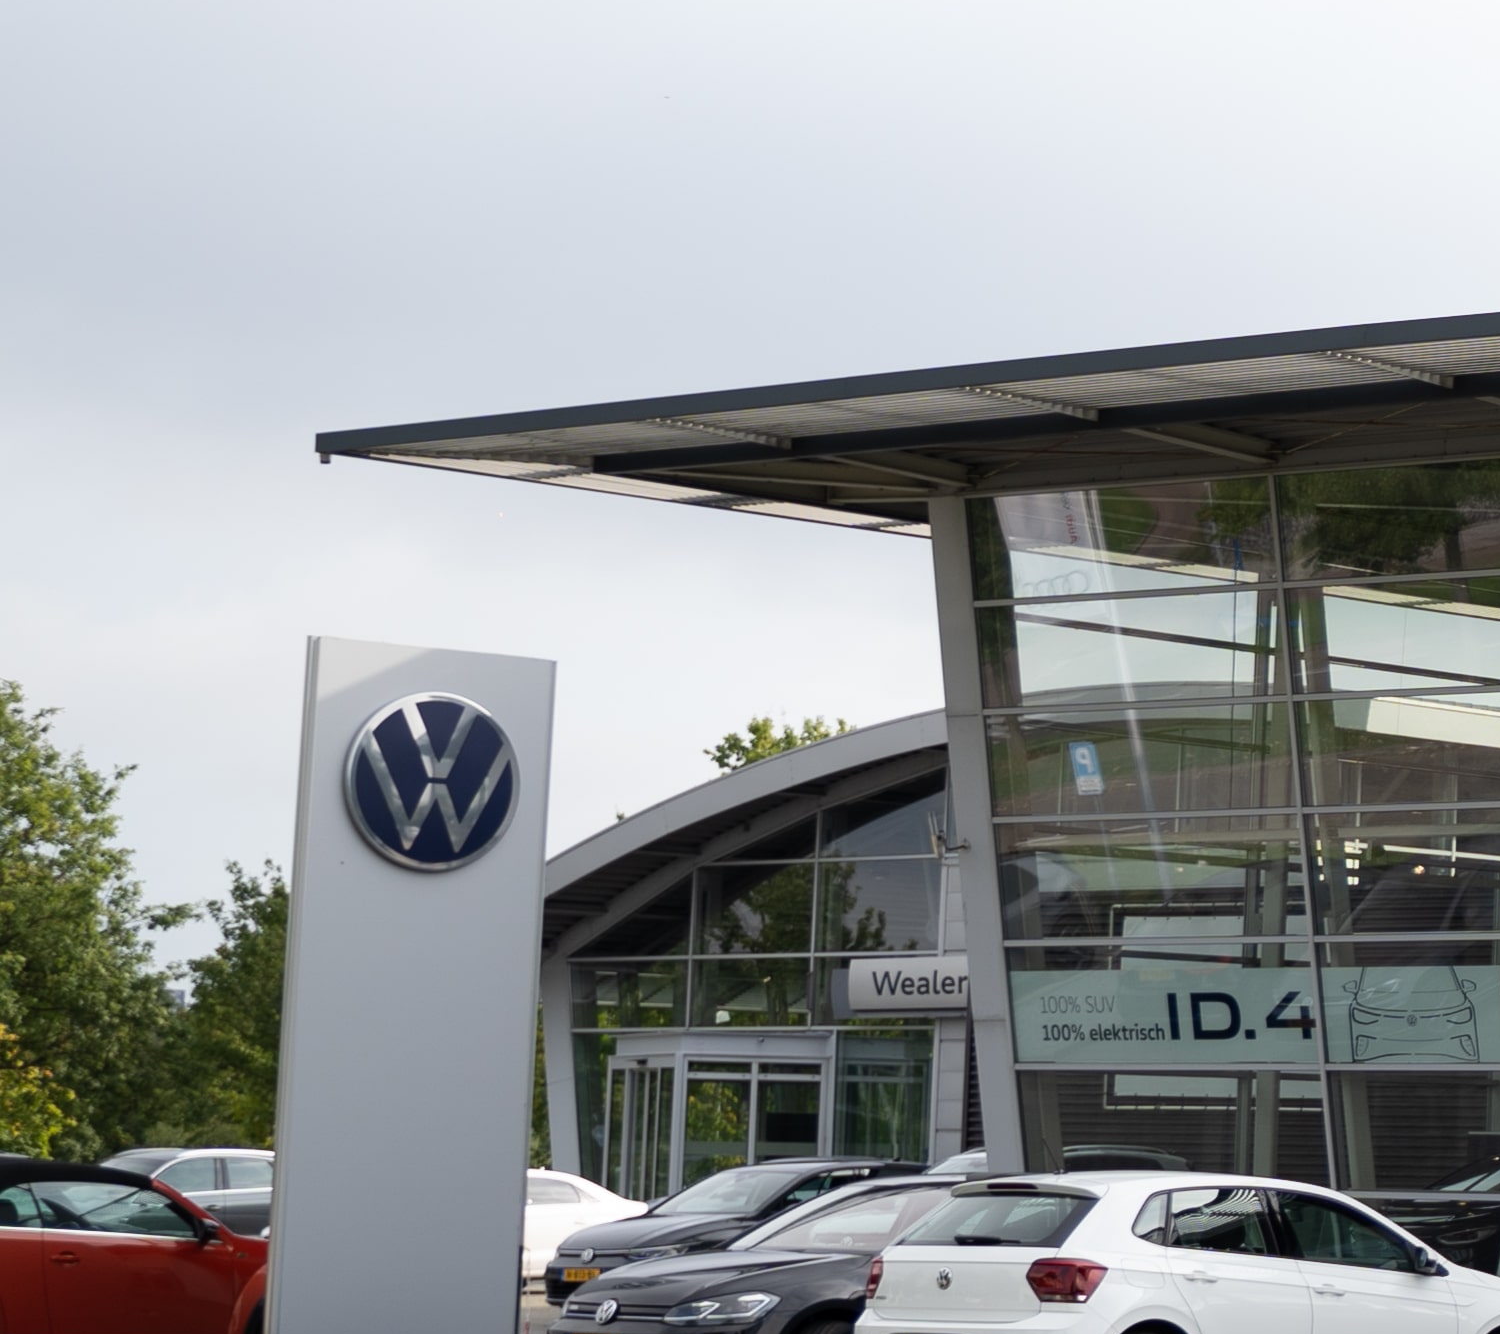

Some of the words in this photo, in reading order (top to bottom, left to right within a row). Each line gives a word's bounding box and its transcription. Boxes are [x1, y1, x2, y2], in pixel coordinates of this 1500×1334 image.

[871, 969, 969, 997] Wealer
[1040, 995, 1081, 1014] 100%
[1085, 995, 1116, 1014] SUV
[1166, 991, 1317, 1041] ID.4
[1042, 1024, 1086, 1042] 100%
[1089, 1022, 1166, 1042] elektrisch
